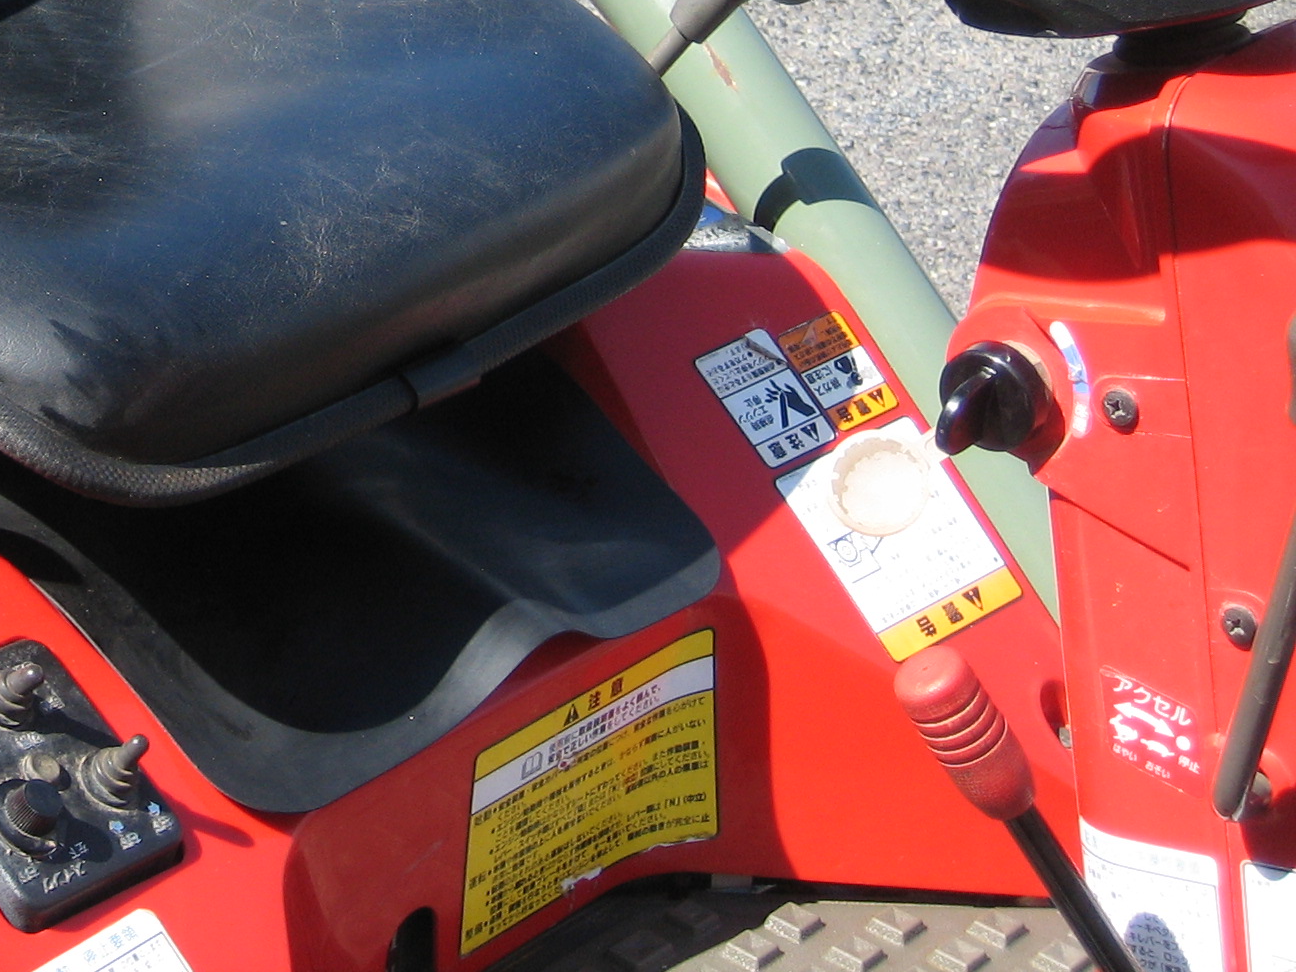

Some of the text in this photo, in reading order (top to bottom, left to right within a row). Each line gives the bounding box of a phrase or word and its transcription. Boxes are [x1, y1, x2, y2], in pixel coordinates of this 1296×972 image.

[735, 404, 769, 425] エンジン
[835, 398, 871, 424] 警告
[766, 432, 805, 459] 注意
[913, 600, 964, 639] 警告
[588, 677, 624, 709] 注意
[1112, 676, 1191, 726] アクセル
[1112, 743, 1137, 762] はやい
[1177, 755, 1202, 774] 停止
[1145, 761, 1171, 779] おそい
